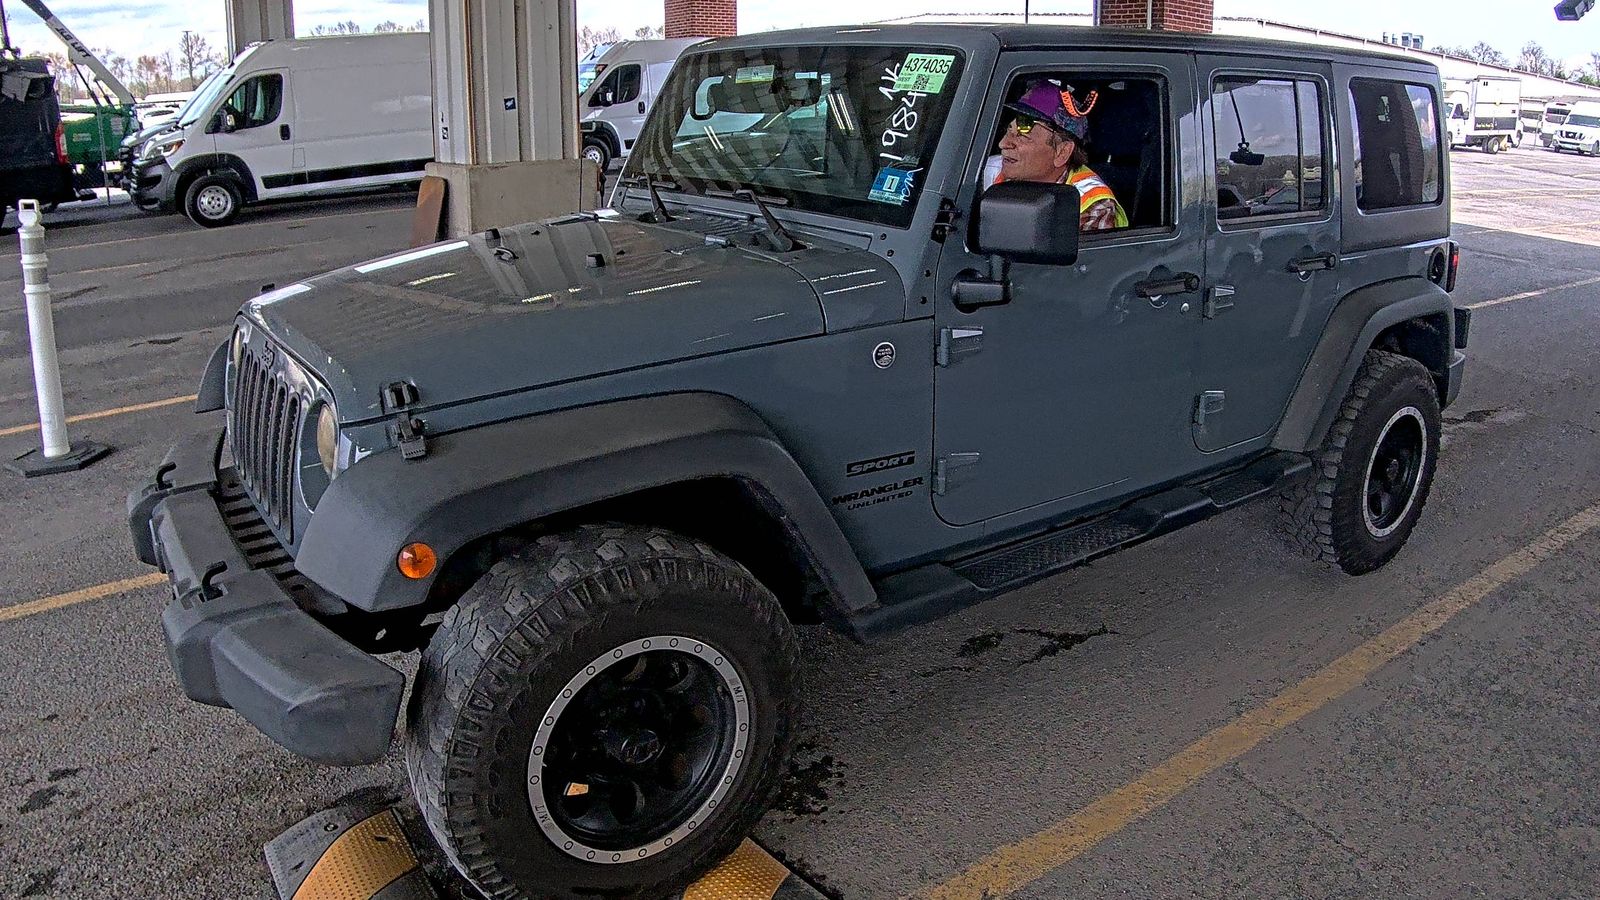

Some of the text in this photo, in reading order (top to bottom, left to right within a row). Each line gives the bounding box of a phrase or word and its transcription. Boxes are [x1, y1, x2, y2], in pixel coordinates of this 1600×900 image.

[71, 41, 91, 58] LIFT
[904, 57, 952, 74] 4374035
[879, 91, 927, 161] 1984
[850, 454, 915, 474] SPORT
[831, 476, 924, 506] WRANGLER
[847, 490, 914, 511] UNLIMITED
